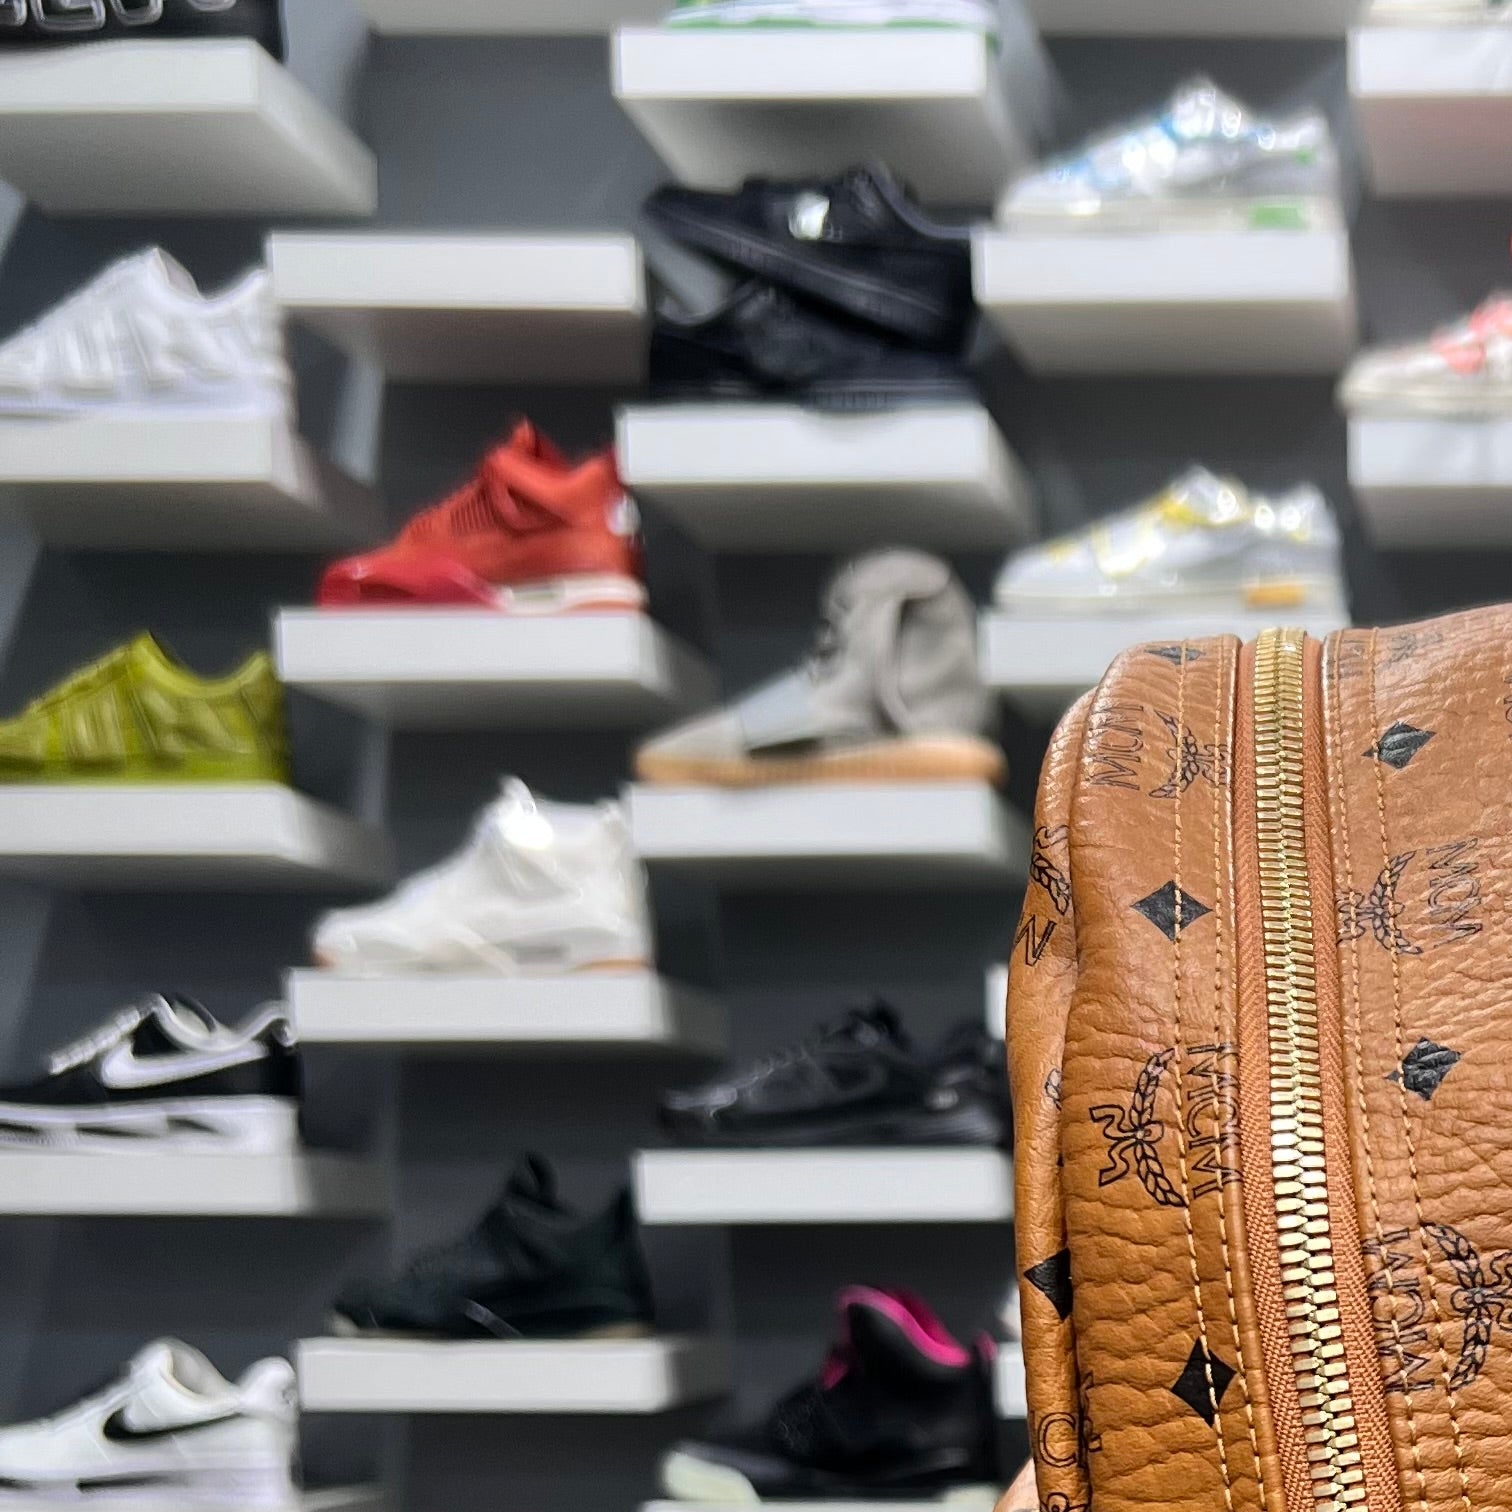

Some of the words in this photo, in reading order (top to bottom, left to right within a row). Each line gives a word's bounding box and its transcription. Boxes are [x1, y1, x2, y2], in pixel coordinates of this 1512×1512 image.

[1427, 838, 1482, 949] MCM
[1187, 1042, 1243, 1199] MCM
[1362, 1227, 1435, 1392] MCM
